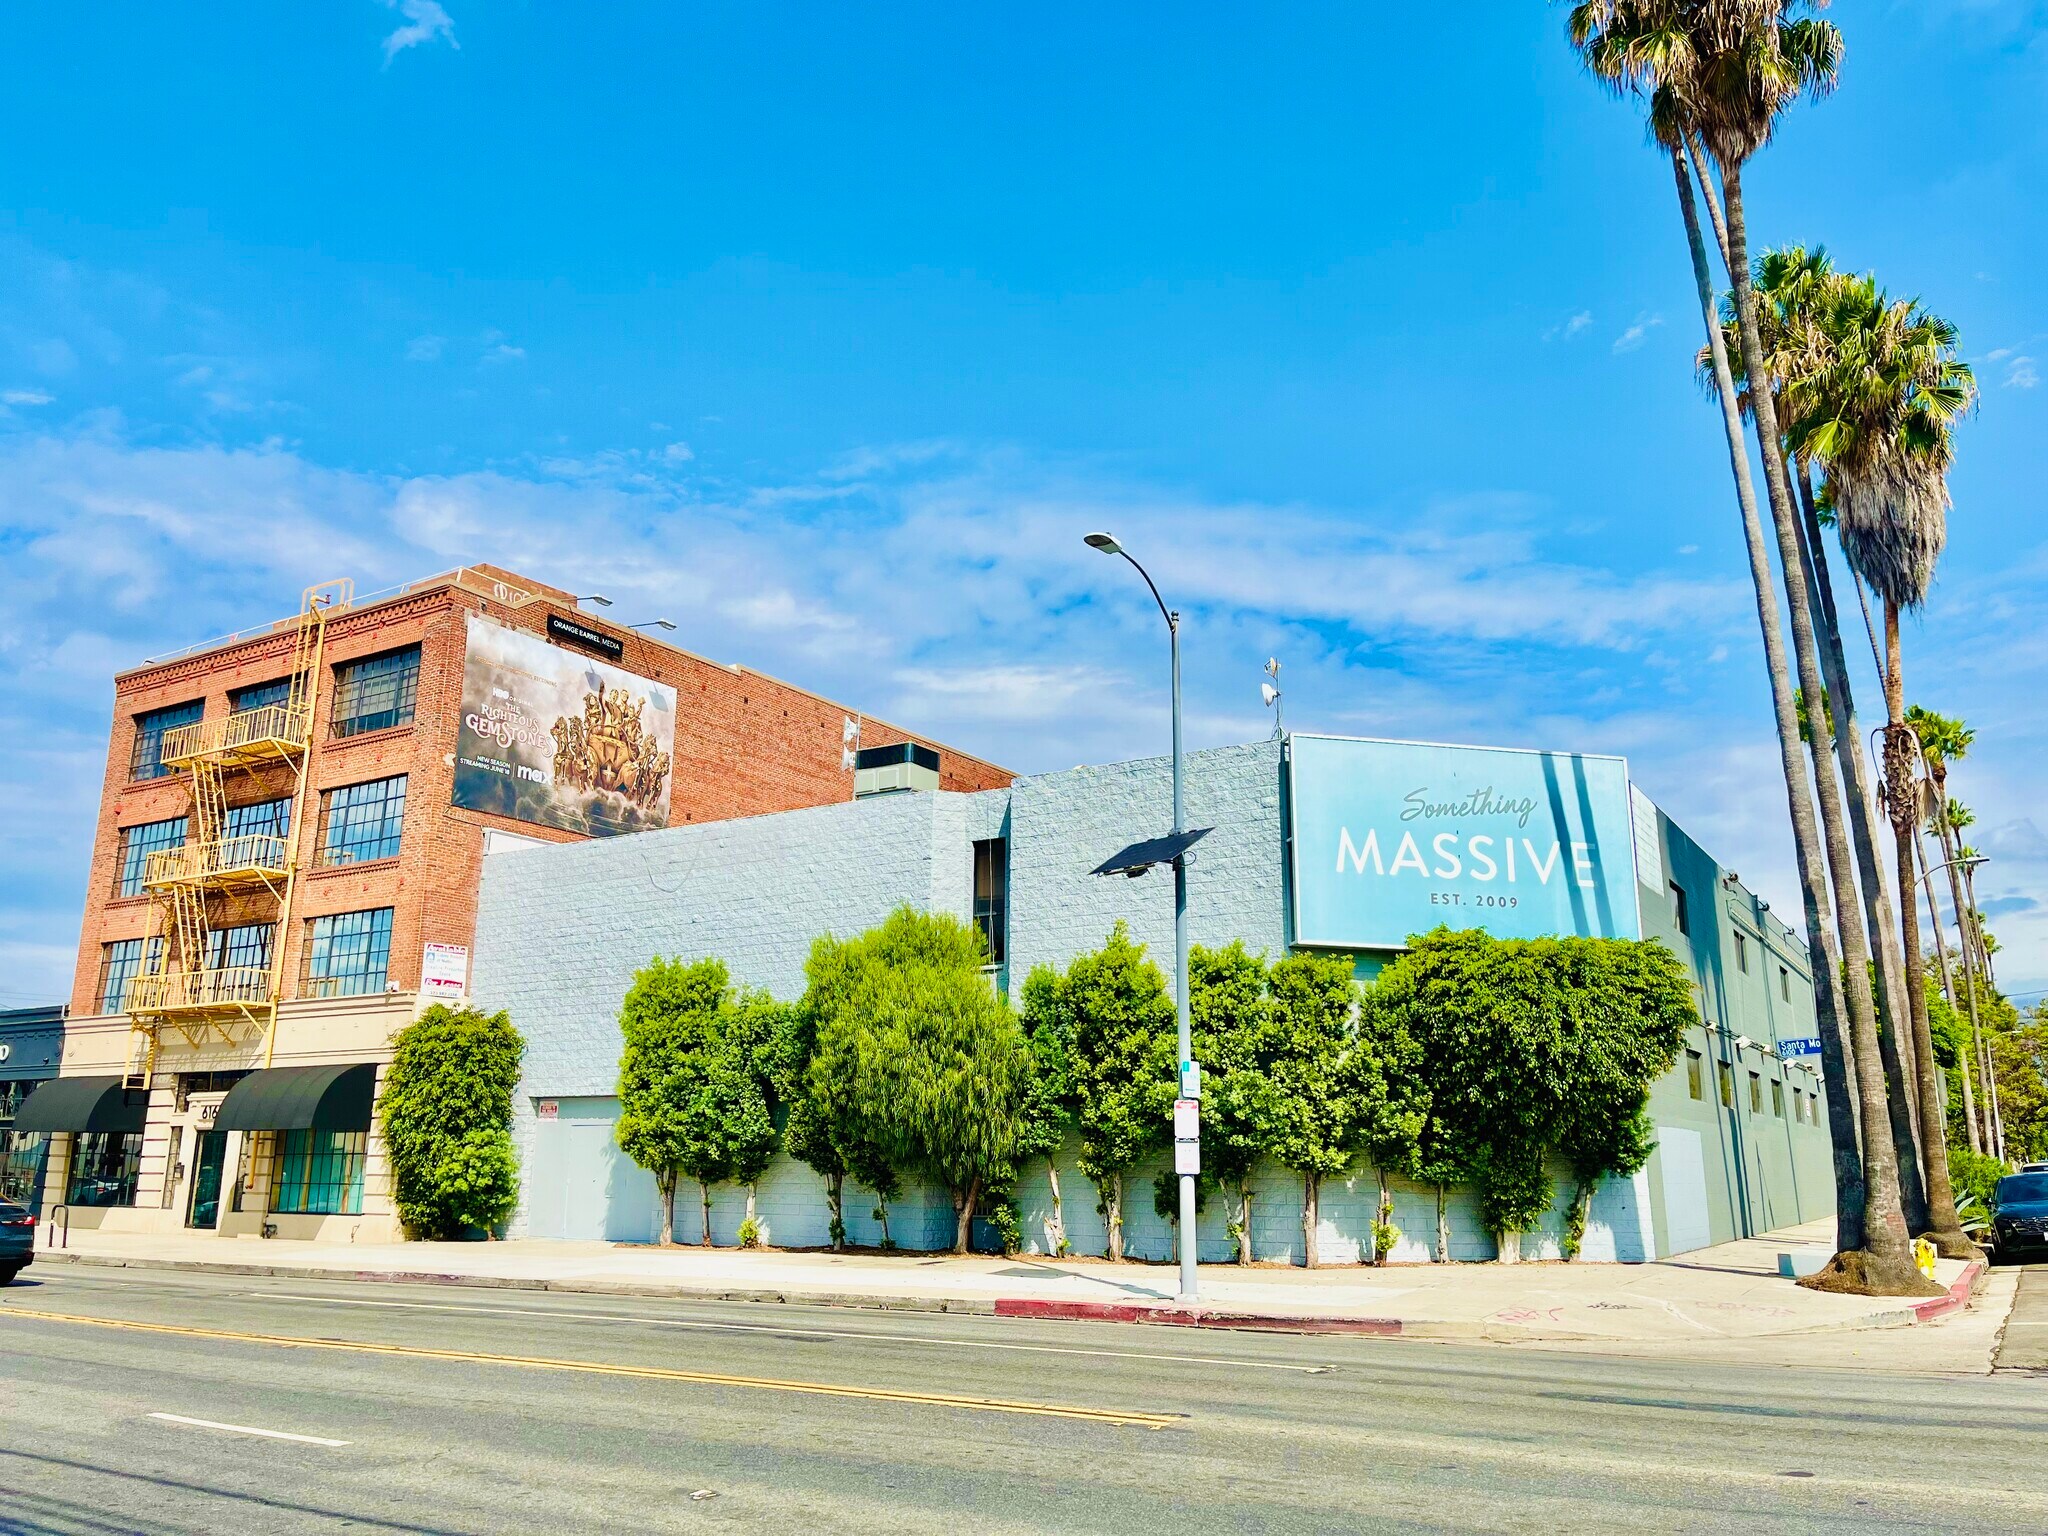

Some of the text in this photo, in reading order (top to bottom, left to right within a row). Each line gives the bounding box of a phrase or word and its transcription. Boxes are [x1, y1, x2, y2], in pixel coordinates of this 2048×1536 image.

[553, 620, 620, 651] ORANGE BARREL MEDIA
[481, 703, 539, 735] RIGHTEOUS
[505, 702, 521, 715] THE
[465, 713, 553, 758] GEMSTONES
[460, 758, 490, 770] STREAMING
[490, 764, 504, 774] JUNE
[476, 755, 510, 769] NEW SEASON
[517, 765, 553, 786] max
[1400, 785, 1538, 829] Something
[1335, 826, 1595, 888] MASSIVE
[1430, 893, 1518, 909] EST. 2009
[1780, 1040, 1806, 1051] Santa
